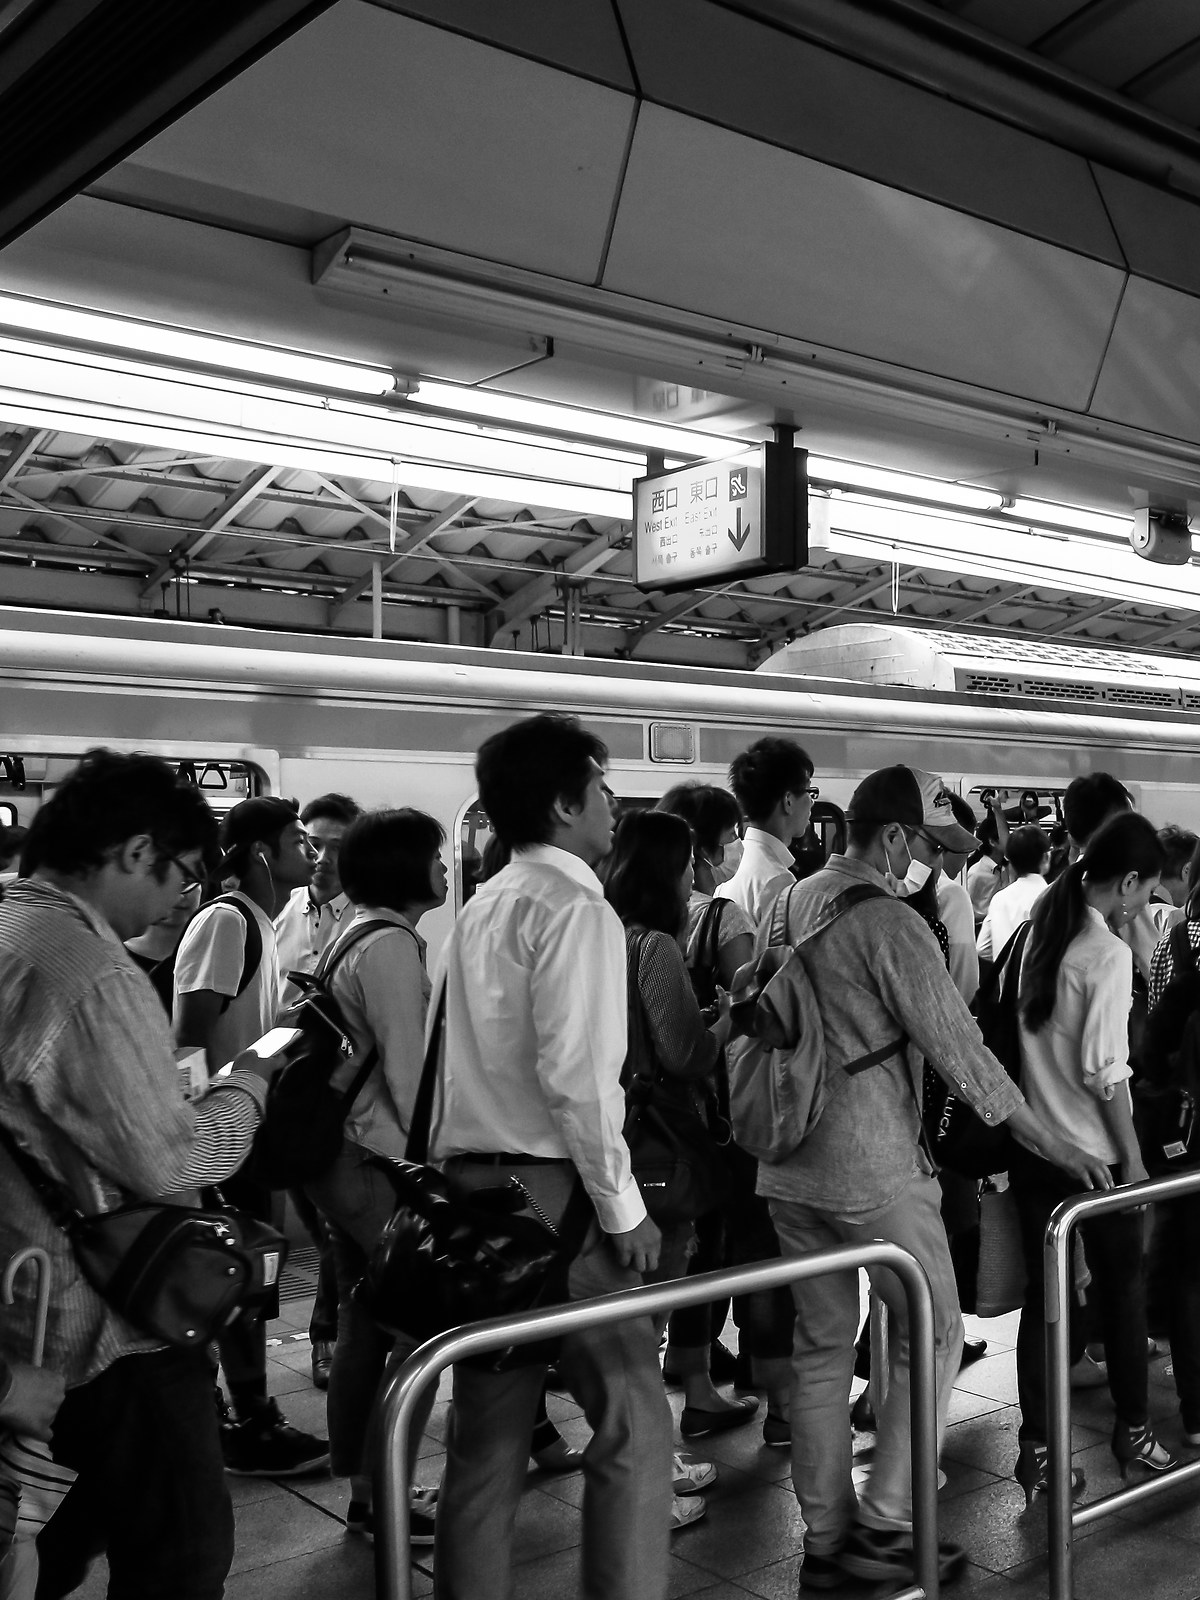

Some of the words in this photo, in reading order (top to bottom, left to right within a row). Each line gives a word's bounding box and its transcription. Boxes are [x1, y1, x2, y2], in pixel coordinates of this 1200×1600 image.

[651, 487, 678, 514] 西口
[690, 476, 718, 504] 東口
[644, 519, 663, 534] West
[664, 516, 678, 529] Exit
[937, 1095, 956, 1137] LUCA
